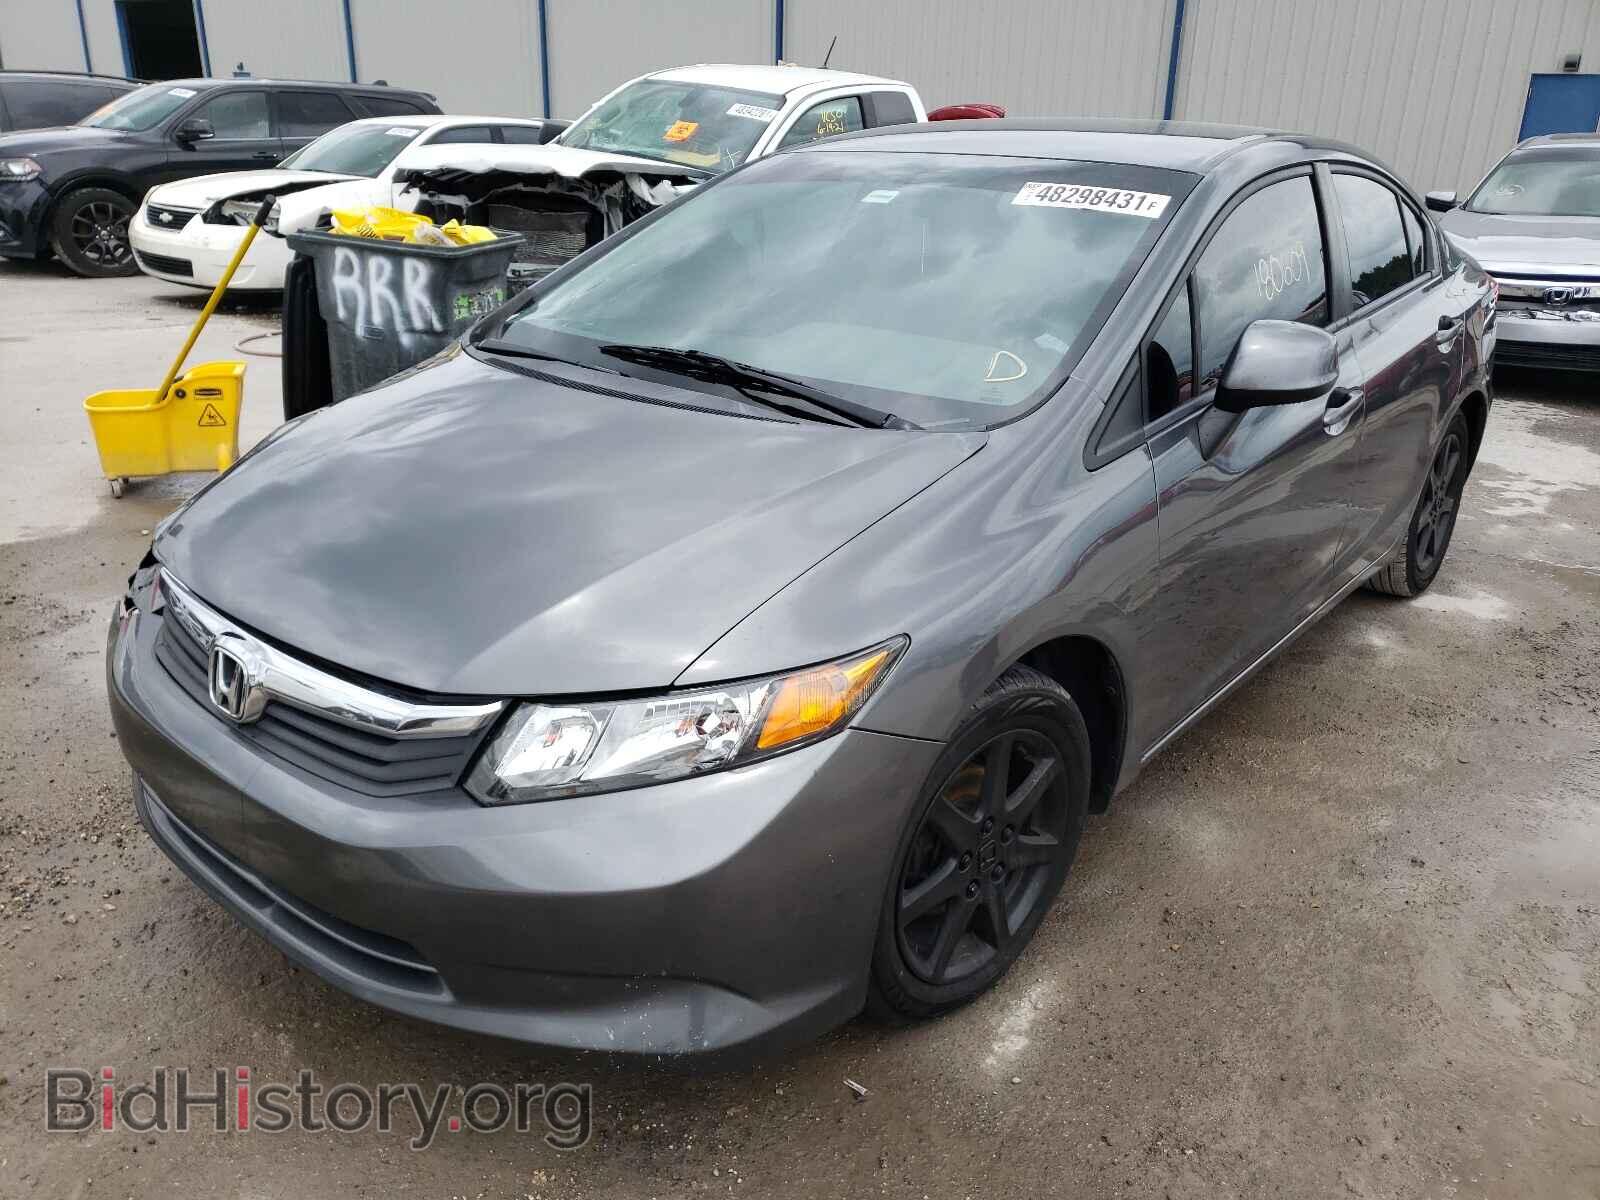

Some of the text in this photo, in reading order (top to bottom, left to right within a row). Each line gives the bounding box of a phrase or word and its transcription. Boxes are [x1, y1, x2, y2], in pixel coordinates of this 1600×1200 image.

[1035, 185, 1148, 211] 48298431
[333, 247, 443, 346] RRR
[984, 350, 1028, 382] D
